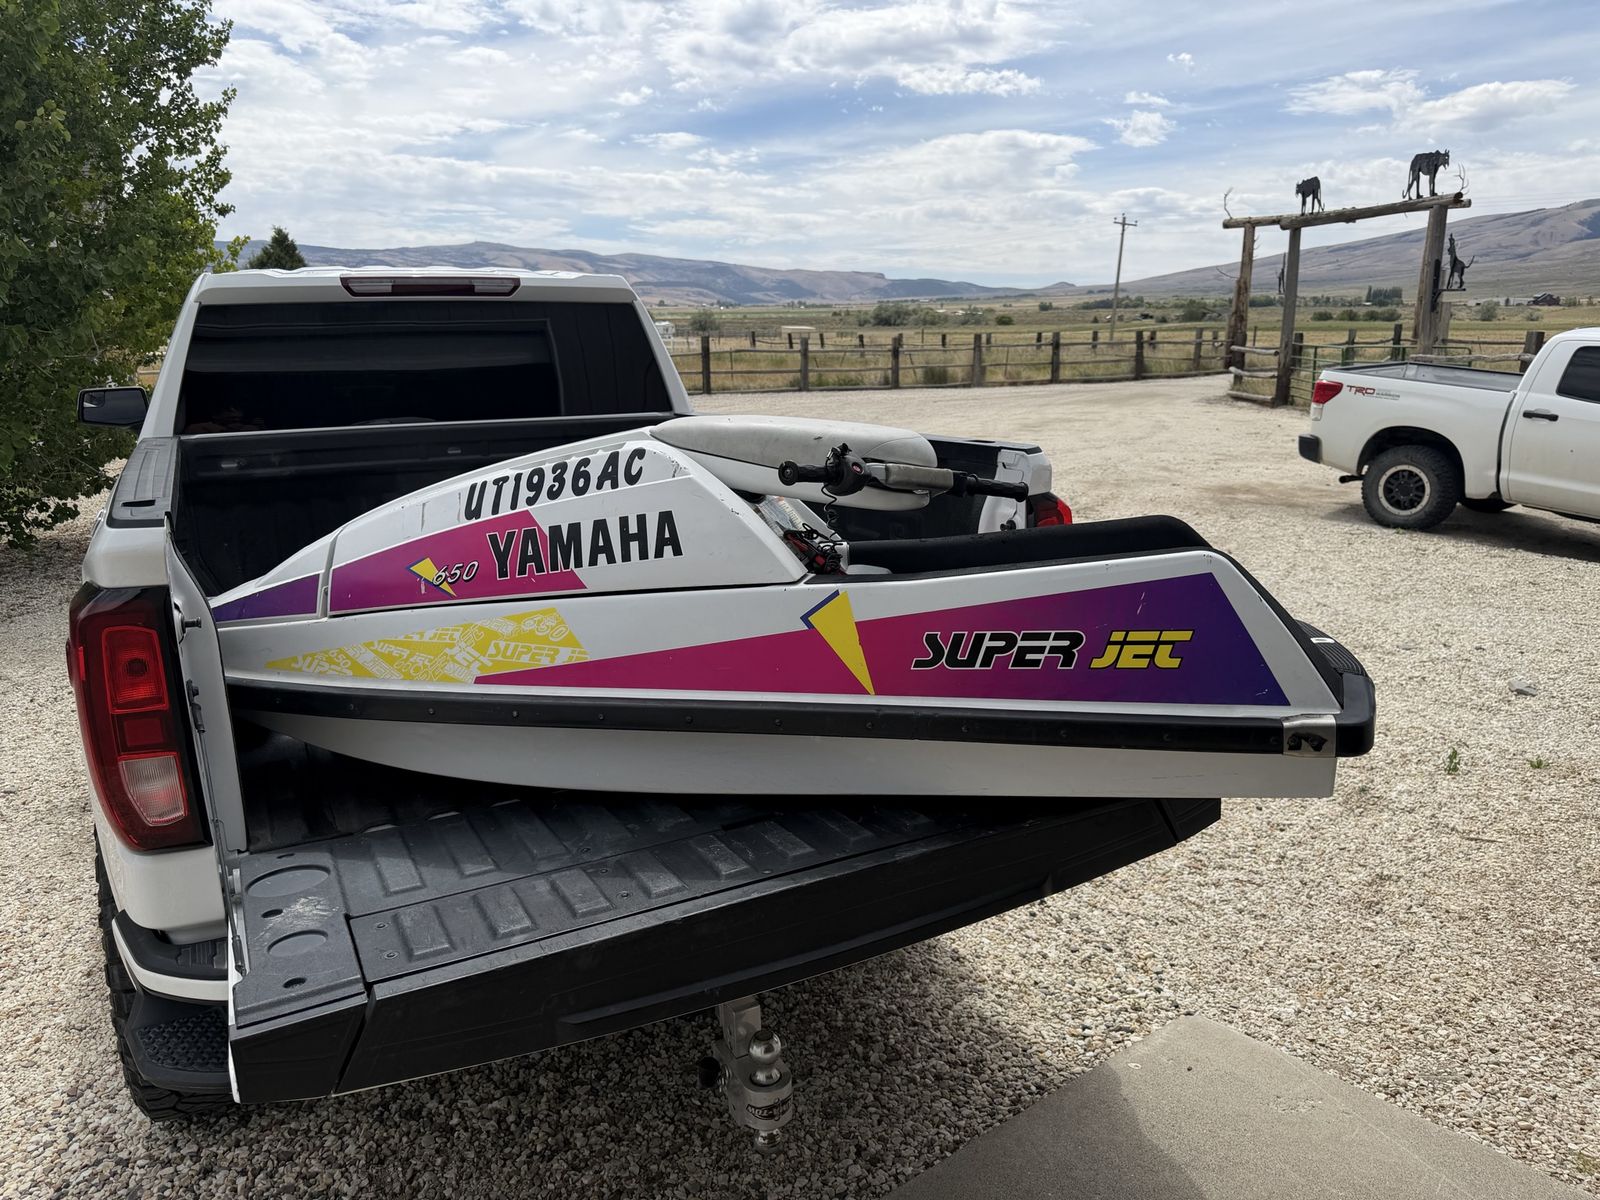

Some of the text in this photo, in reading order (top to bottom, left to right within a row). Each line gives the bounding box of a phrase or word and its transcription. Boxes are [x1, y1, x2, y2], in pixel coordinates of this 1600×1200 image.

[487, 510, 684, 580] YAMAHA
[432, 561, 479, 586] 650
[486, 640, 562, 664] SUPER
[910, 630, 1195, 670] SUPER JET
